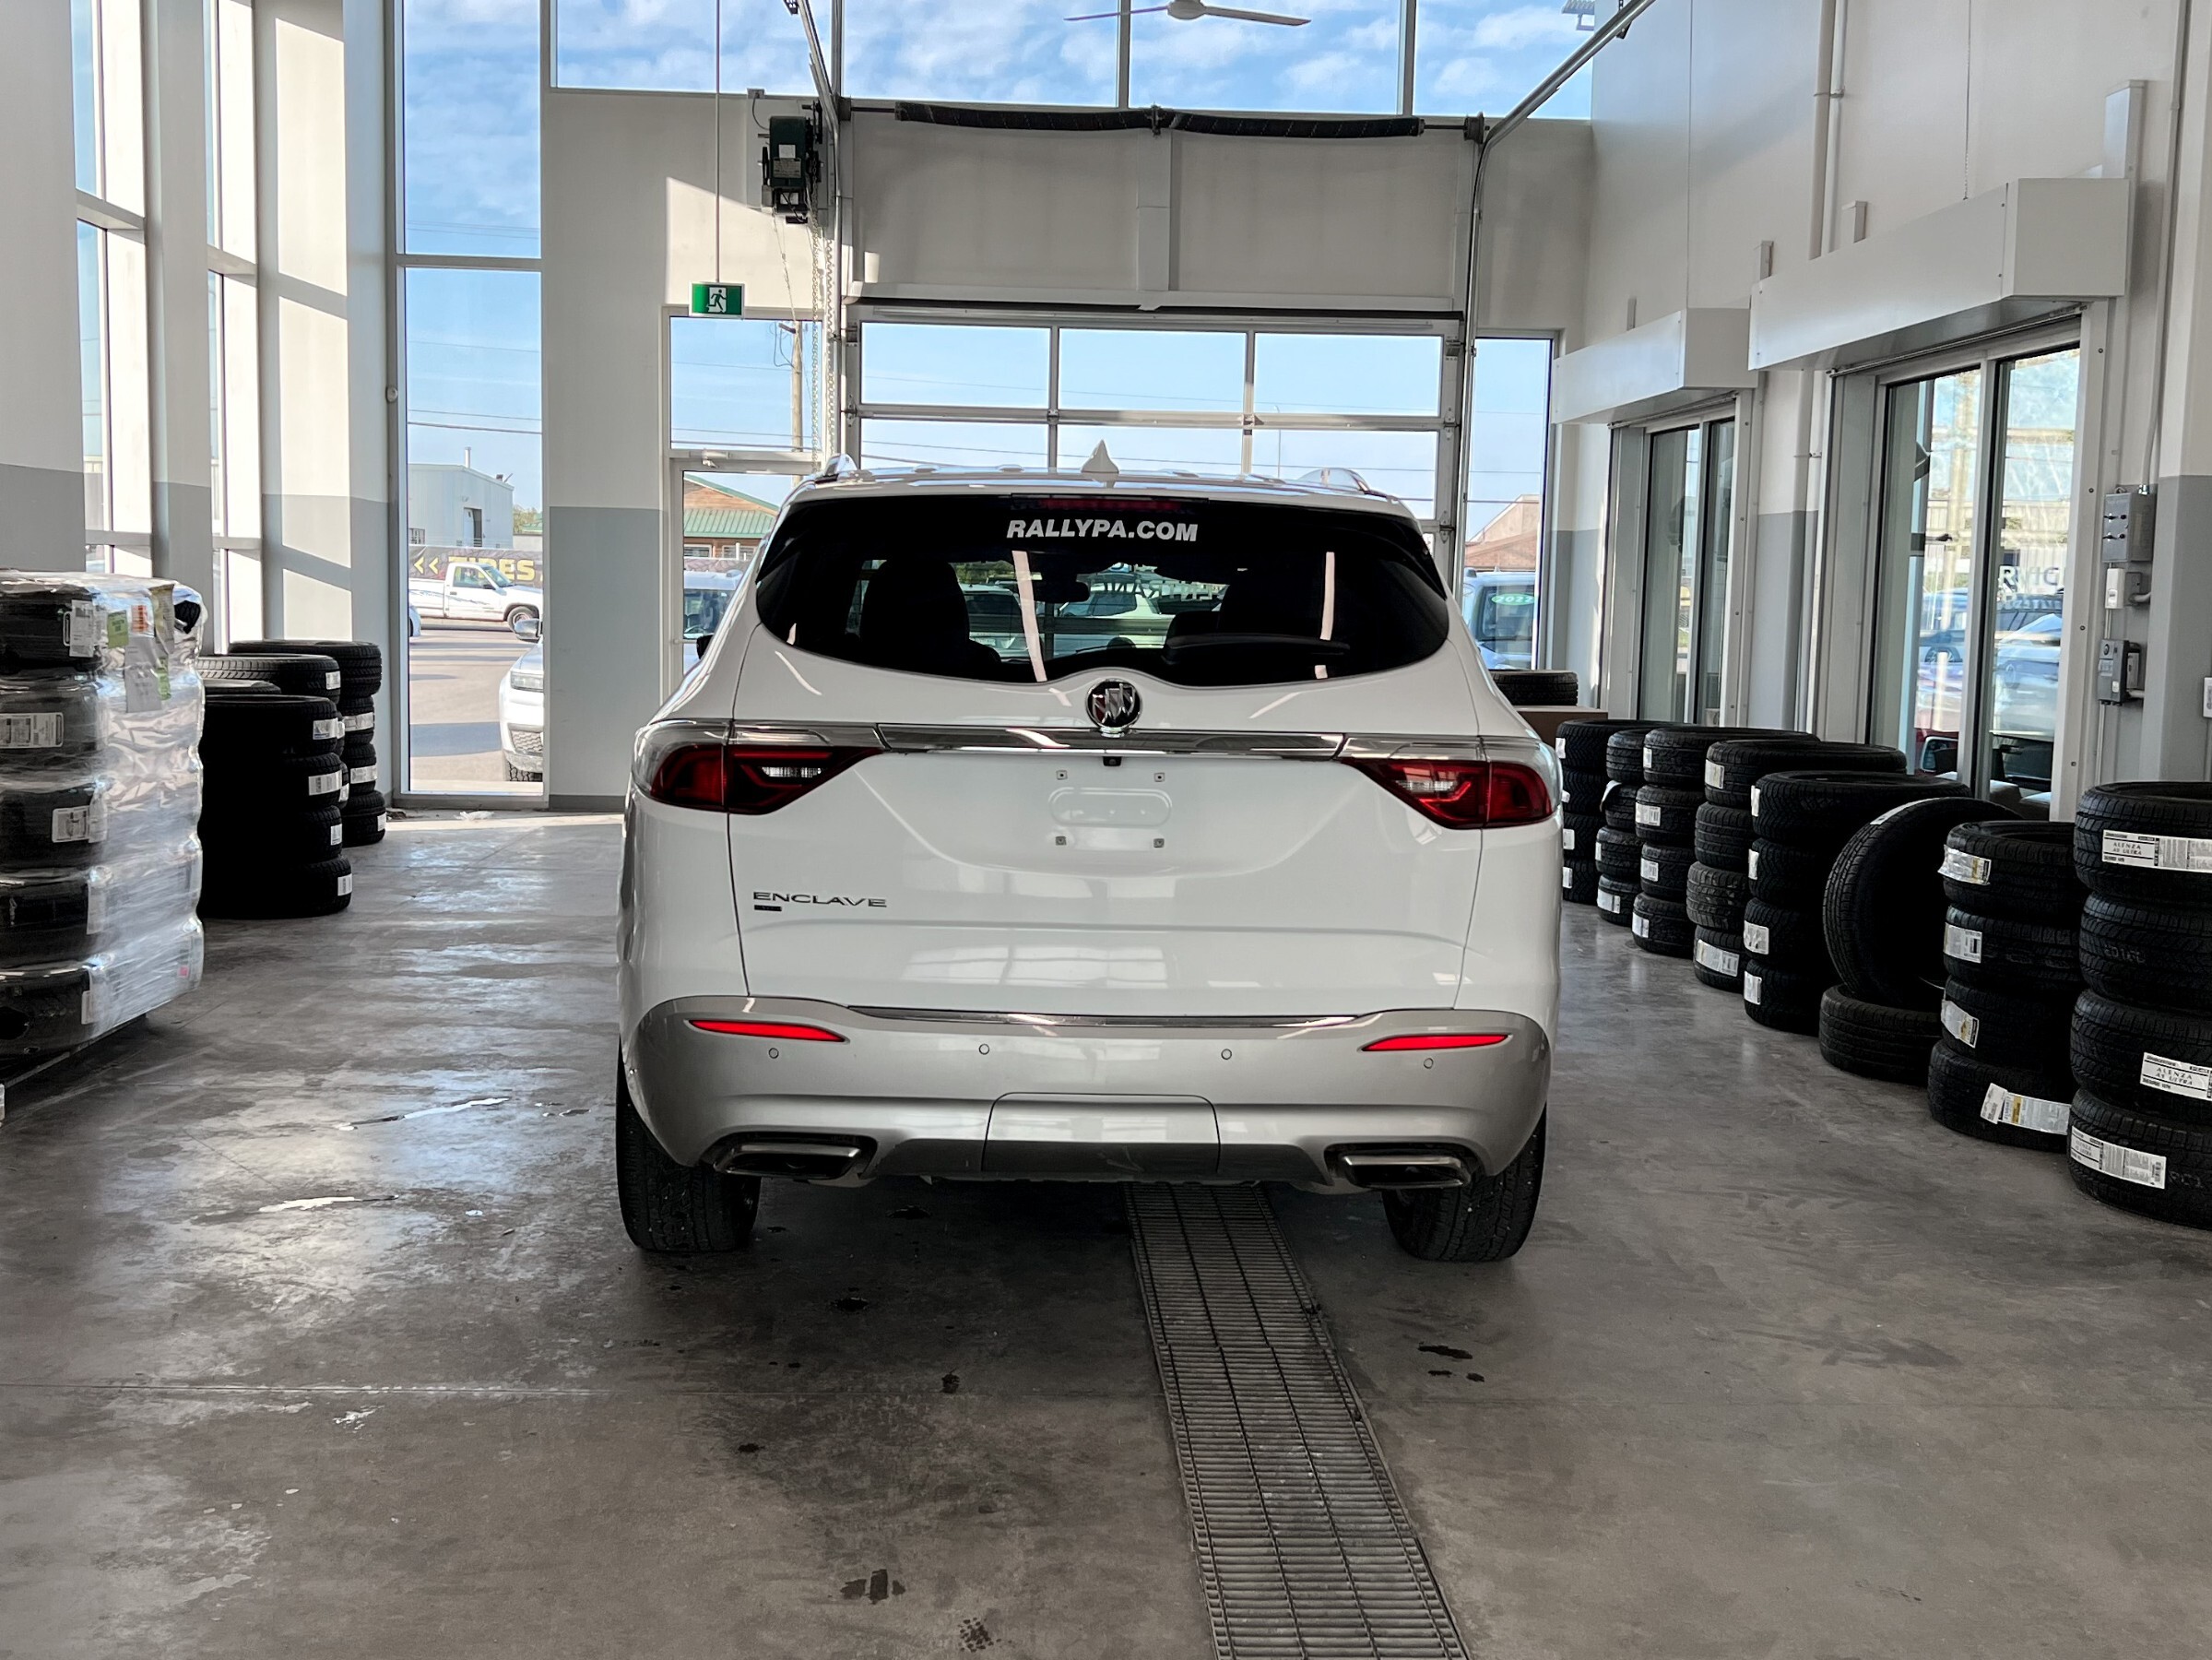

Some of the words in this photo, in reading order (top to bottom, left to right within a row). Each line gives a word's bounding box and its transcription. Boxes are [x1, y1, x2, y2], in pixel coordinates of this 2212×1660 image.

[1006, 518, 1199, 542] RALLYPA.COM
[753, 891, 887, 907] ENCLAVE
[2157, 1067, 2193, 1080] ALENZA
